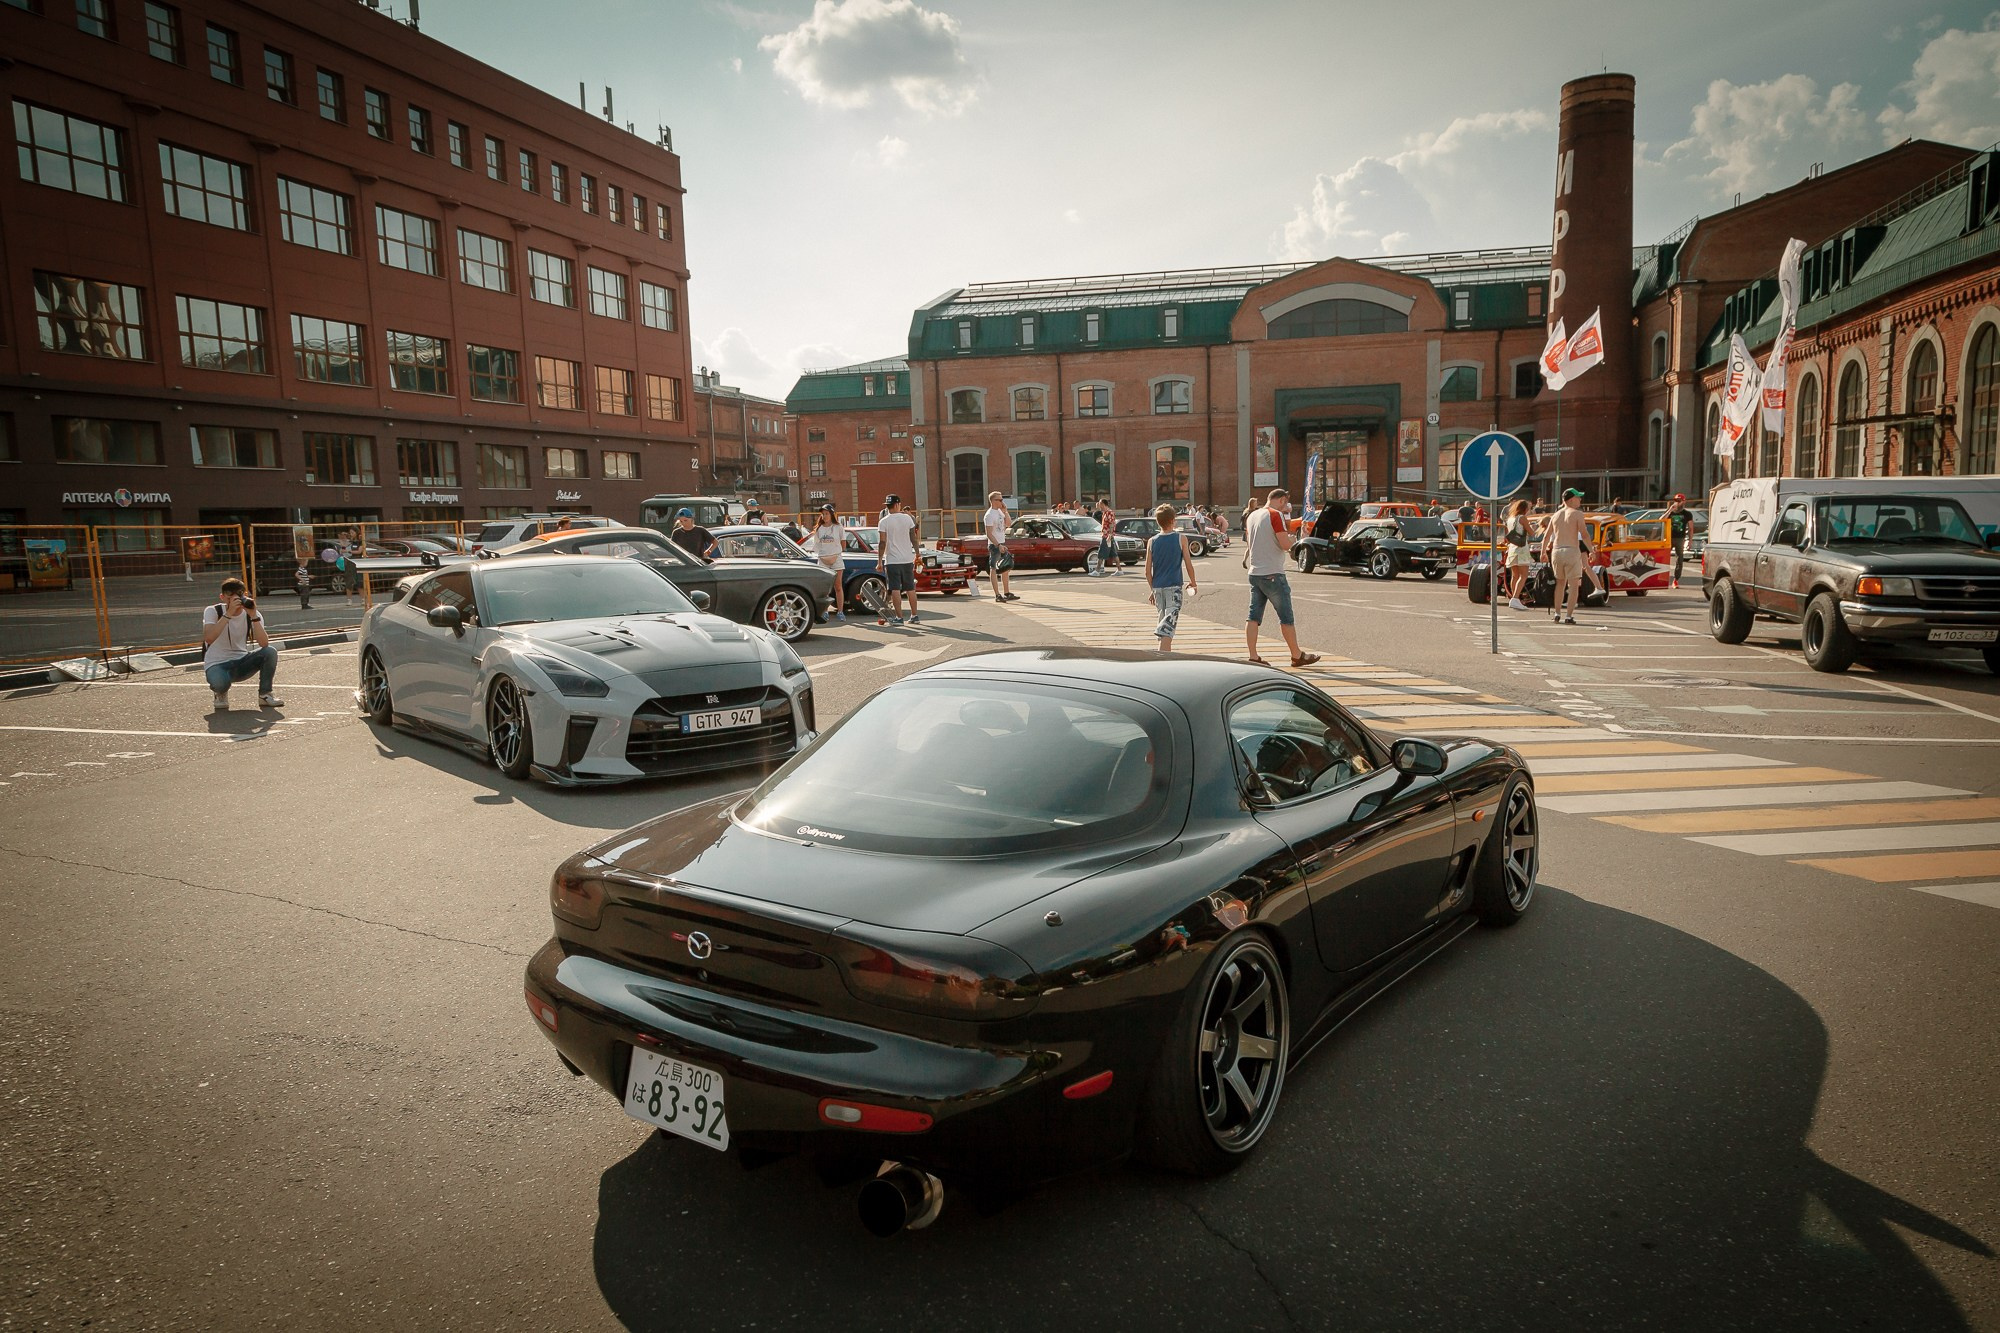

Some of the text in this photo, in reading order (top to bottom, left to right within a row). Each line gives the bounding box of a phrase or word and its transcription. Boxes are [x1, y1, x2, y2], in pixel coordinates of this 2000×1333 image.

[691, 458, 699, 469] 22
[62, 492, 172, 503] АПТЕКА РИГЛА
[409, 491, 459, 504] Кафе Атриум
[696, 709, 754, 729] GTR 947
[648, 1080, 725, 1142] 83-92
